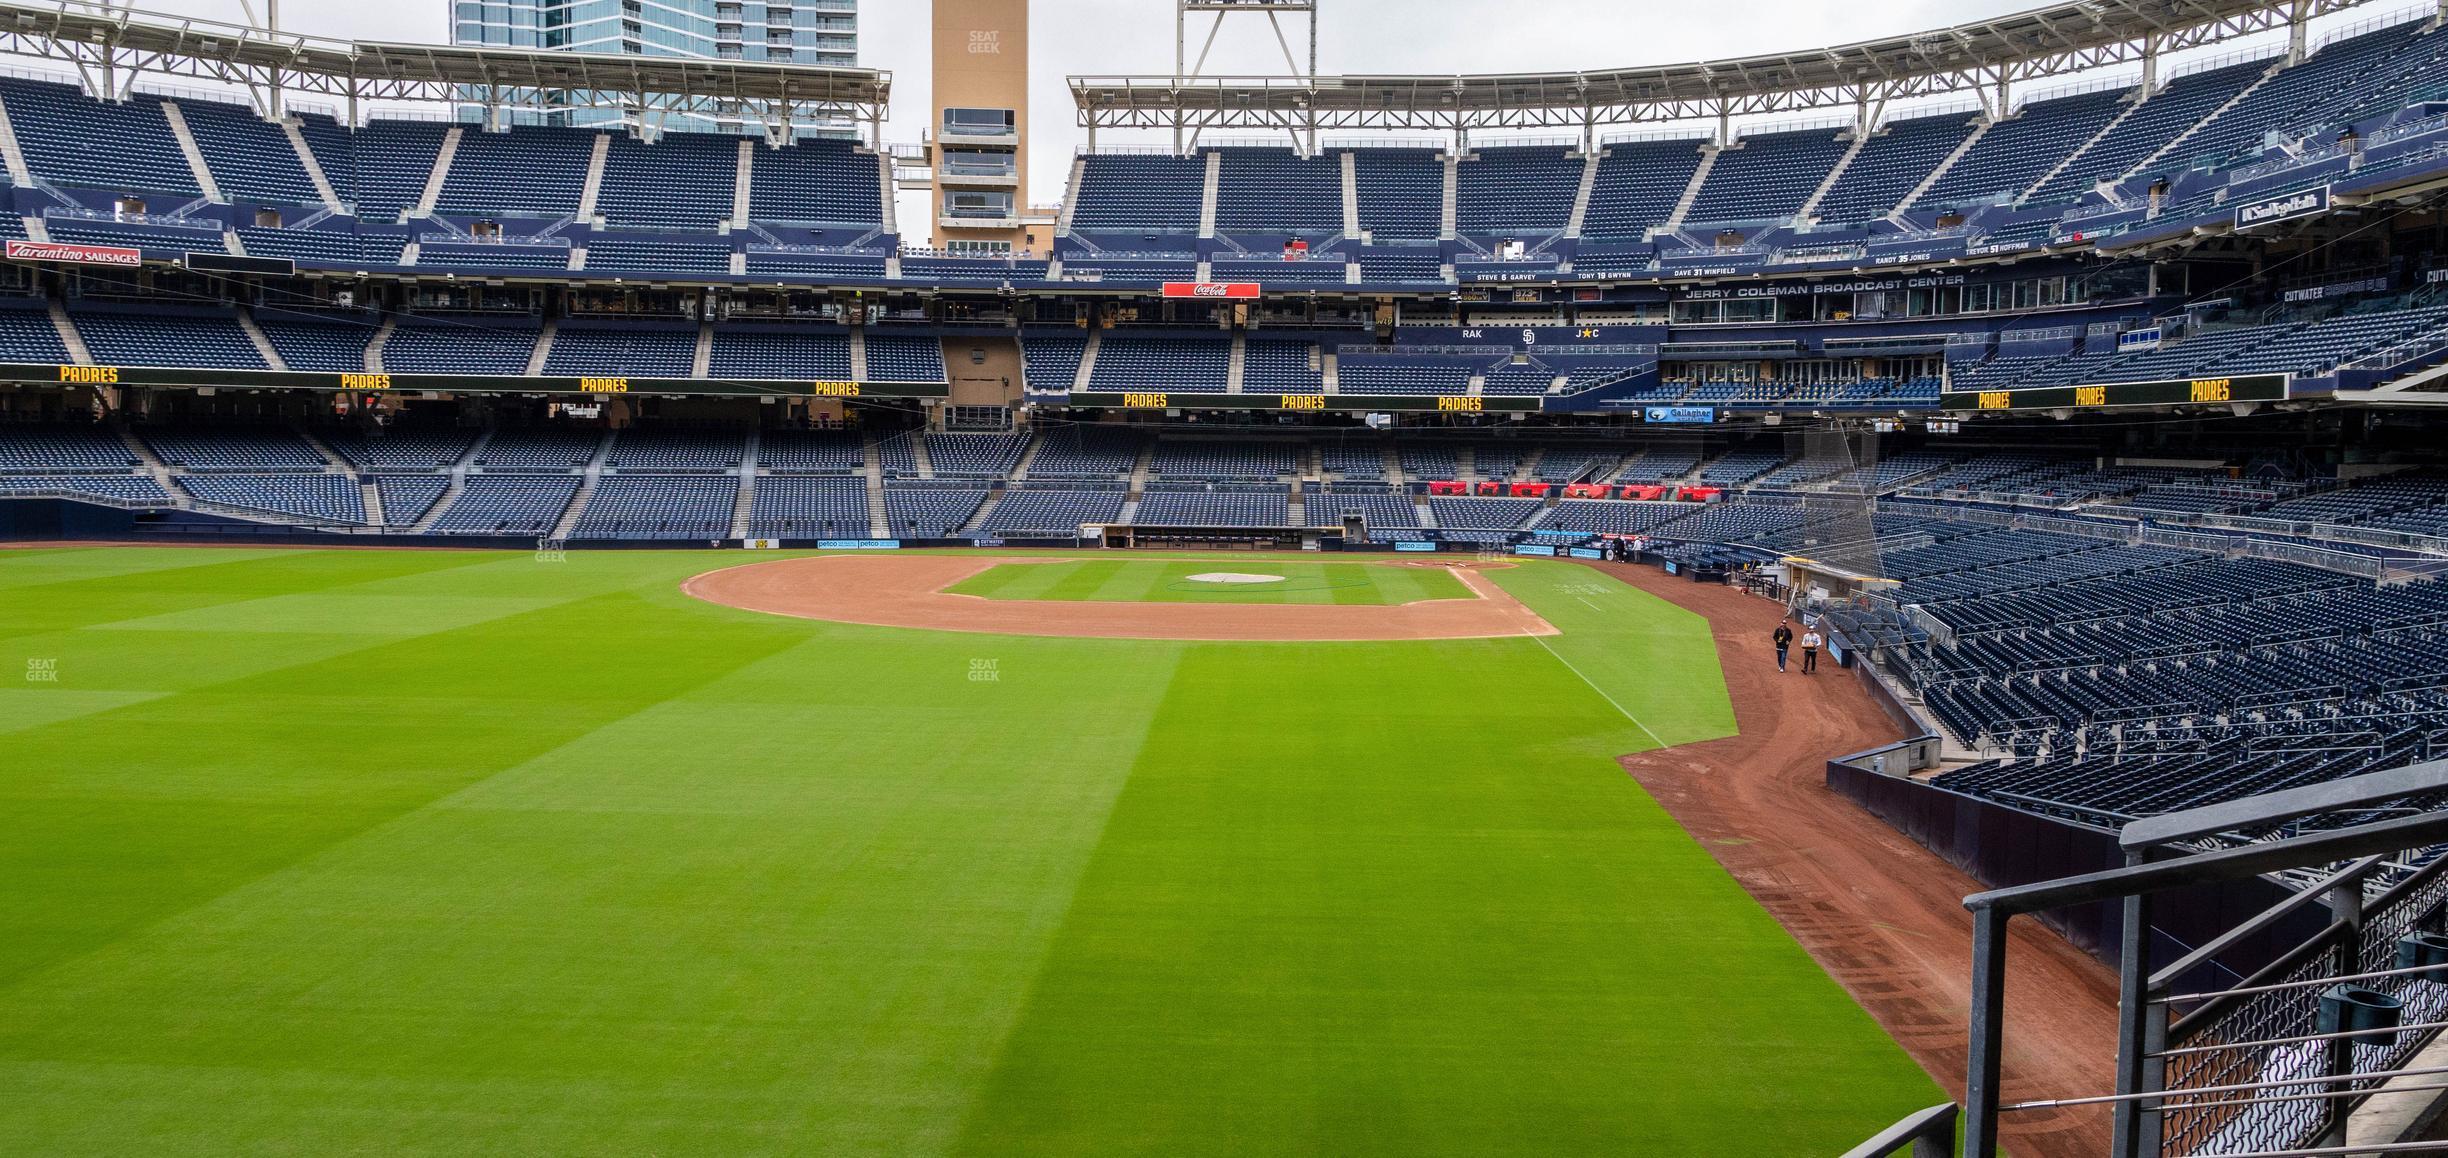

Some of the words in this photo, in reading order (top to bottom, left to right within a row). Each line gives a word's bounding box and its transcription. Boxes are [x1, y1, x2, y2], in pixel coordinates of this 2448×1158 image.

[9, 243, 83, 260] Tarantino
[85, 251, 139, 264] SAUSAGES
[1966, 247, 1989, 255] TREVOR
[1990, 245, 1999, 253] 51
[1999, 242, 2029, 252] HOFFMAN
[1193, 284, 1227, 296] Coca-Cola
[1686, 289, 1731, 299] JERRY
[1737, 285, 1808, 297] COLEMAN
[1813, 280, 1903, 293] BROADCAST
[1908, 275, 1964, 287] CENTER
[2284, 286, 2323, 302] CUTWATER
[1462, 330, 1482, 338] RAK
[60, 365, 118, 382] PADRES
[341, 374, 390, 389] PADRES
[581, 377, 627, 392] PADRES
[816, 382, 859, 396] PADRES
[2076, 386, 2105, 406] PADRES
[2191, 379, 2229, 402] PADRES
[1124, 393, 1167, 407] PADRES
[1282, 395, 1324, 409] PADRES
[1438, 397, 1481, 411] PADRES
[1978, 391, 2010, 409] PADRES
[1670, 408, 1710, 417] Gallagher
